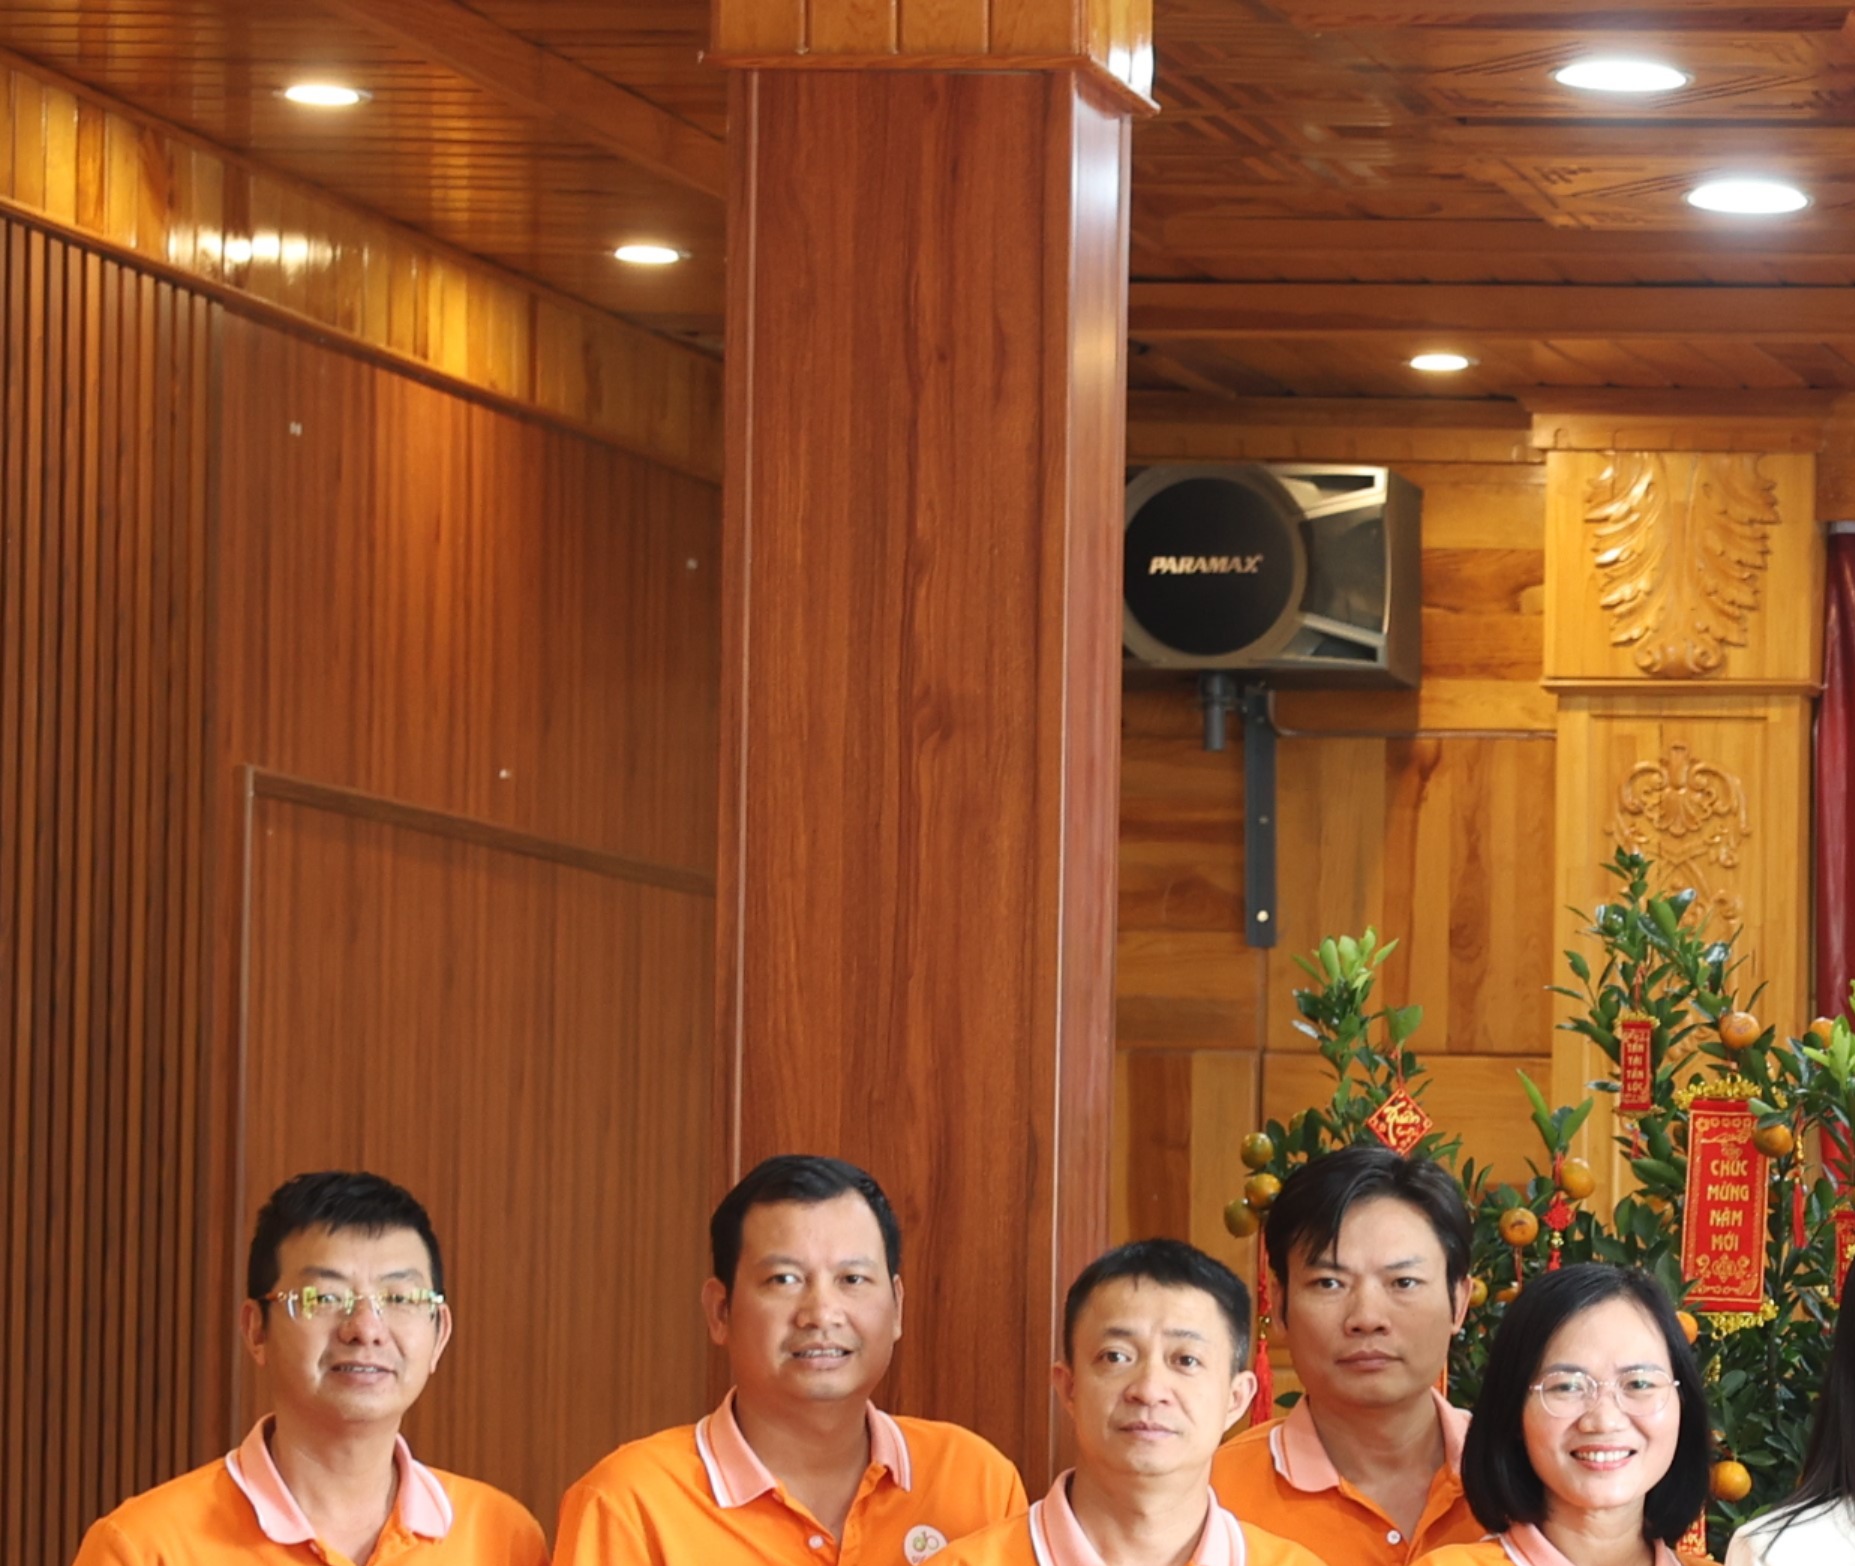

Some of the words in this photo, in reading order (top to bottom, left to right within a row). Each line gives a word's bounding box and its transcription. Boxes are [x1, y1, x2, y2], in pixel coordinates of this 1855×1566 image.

[1149, 555, 1263, 574] PARAMAX
[1707, 1182, 1749, 1201] MỪNG
[1711, 1232, 1739, 1251] MỚI
